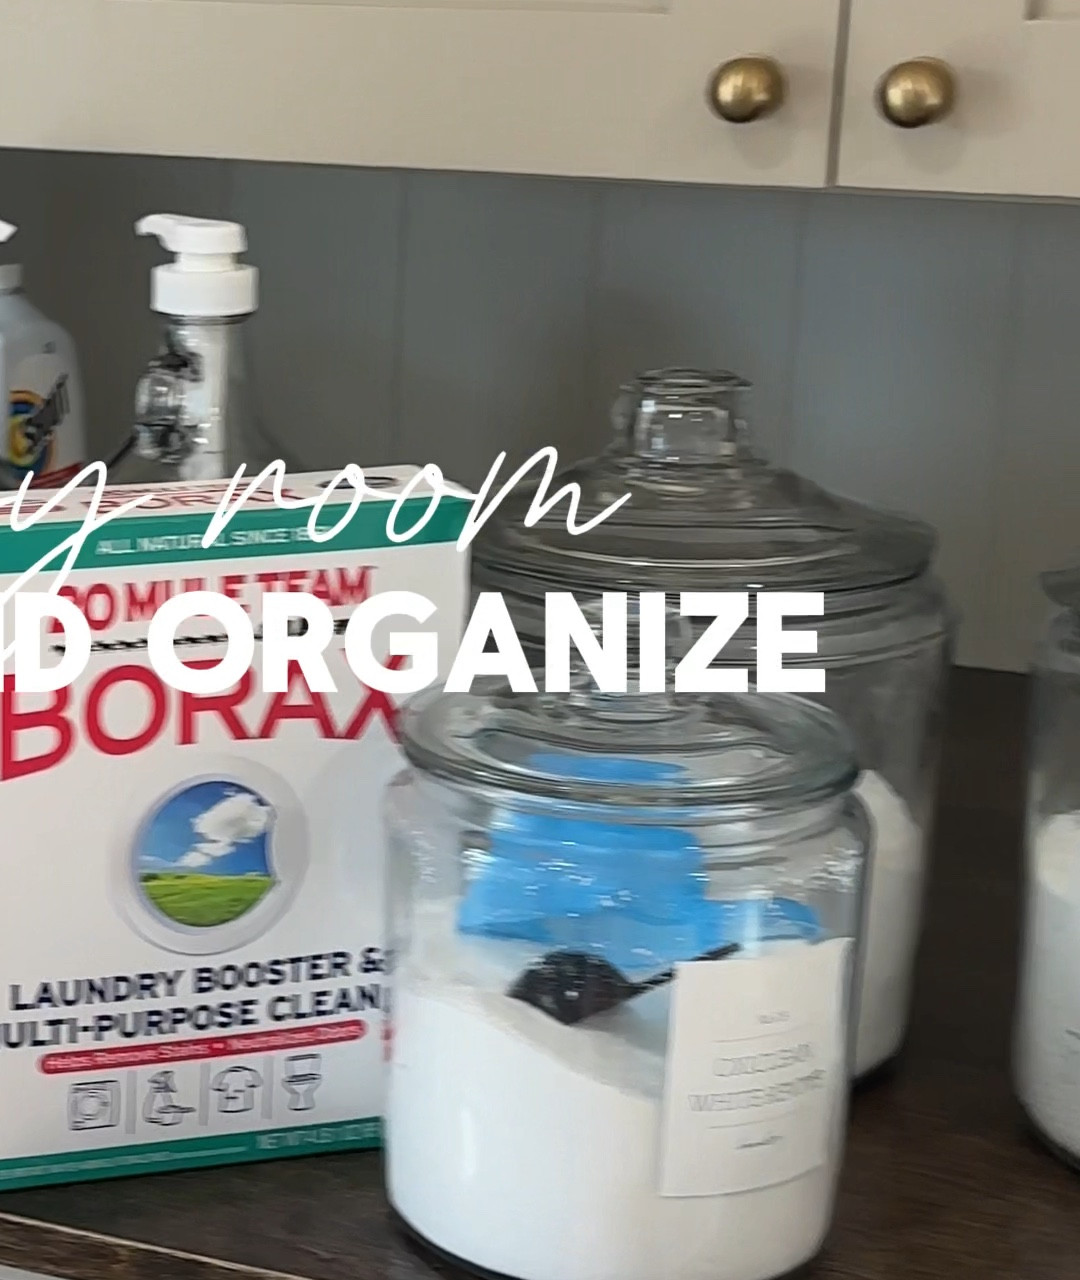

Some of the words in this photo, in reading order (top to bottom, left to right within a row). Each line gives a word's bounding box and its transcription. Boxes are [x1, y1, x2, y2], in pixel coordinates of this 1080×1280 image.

[135, 531, 230, 553] NATURL
[230, 527, 291, 546] SINCE
[9, 969, 185, 1011] LAUNDRY
[192, 950, 353, 993] BOOSTER
[358, 946, 389, 974] &
[266, 983, 391, 1023] CLEAN
